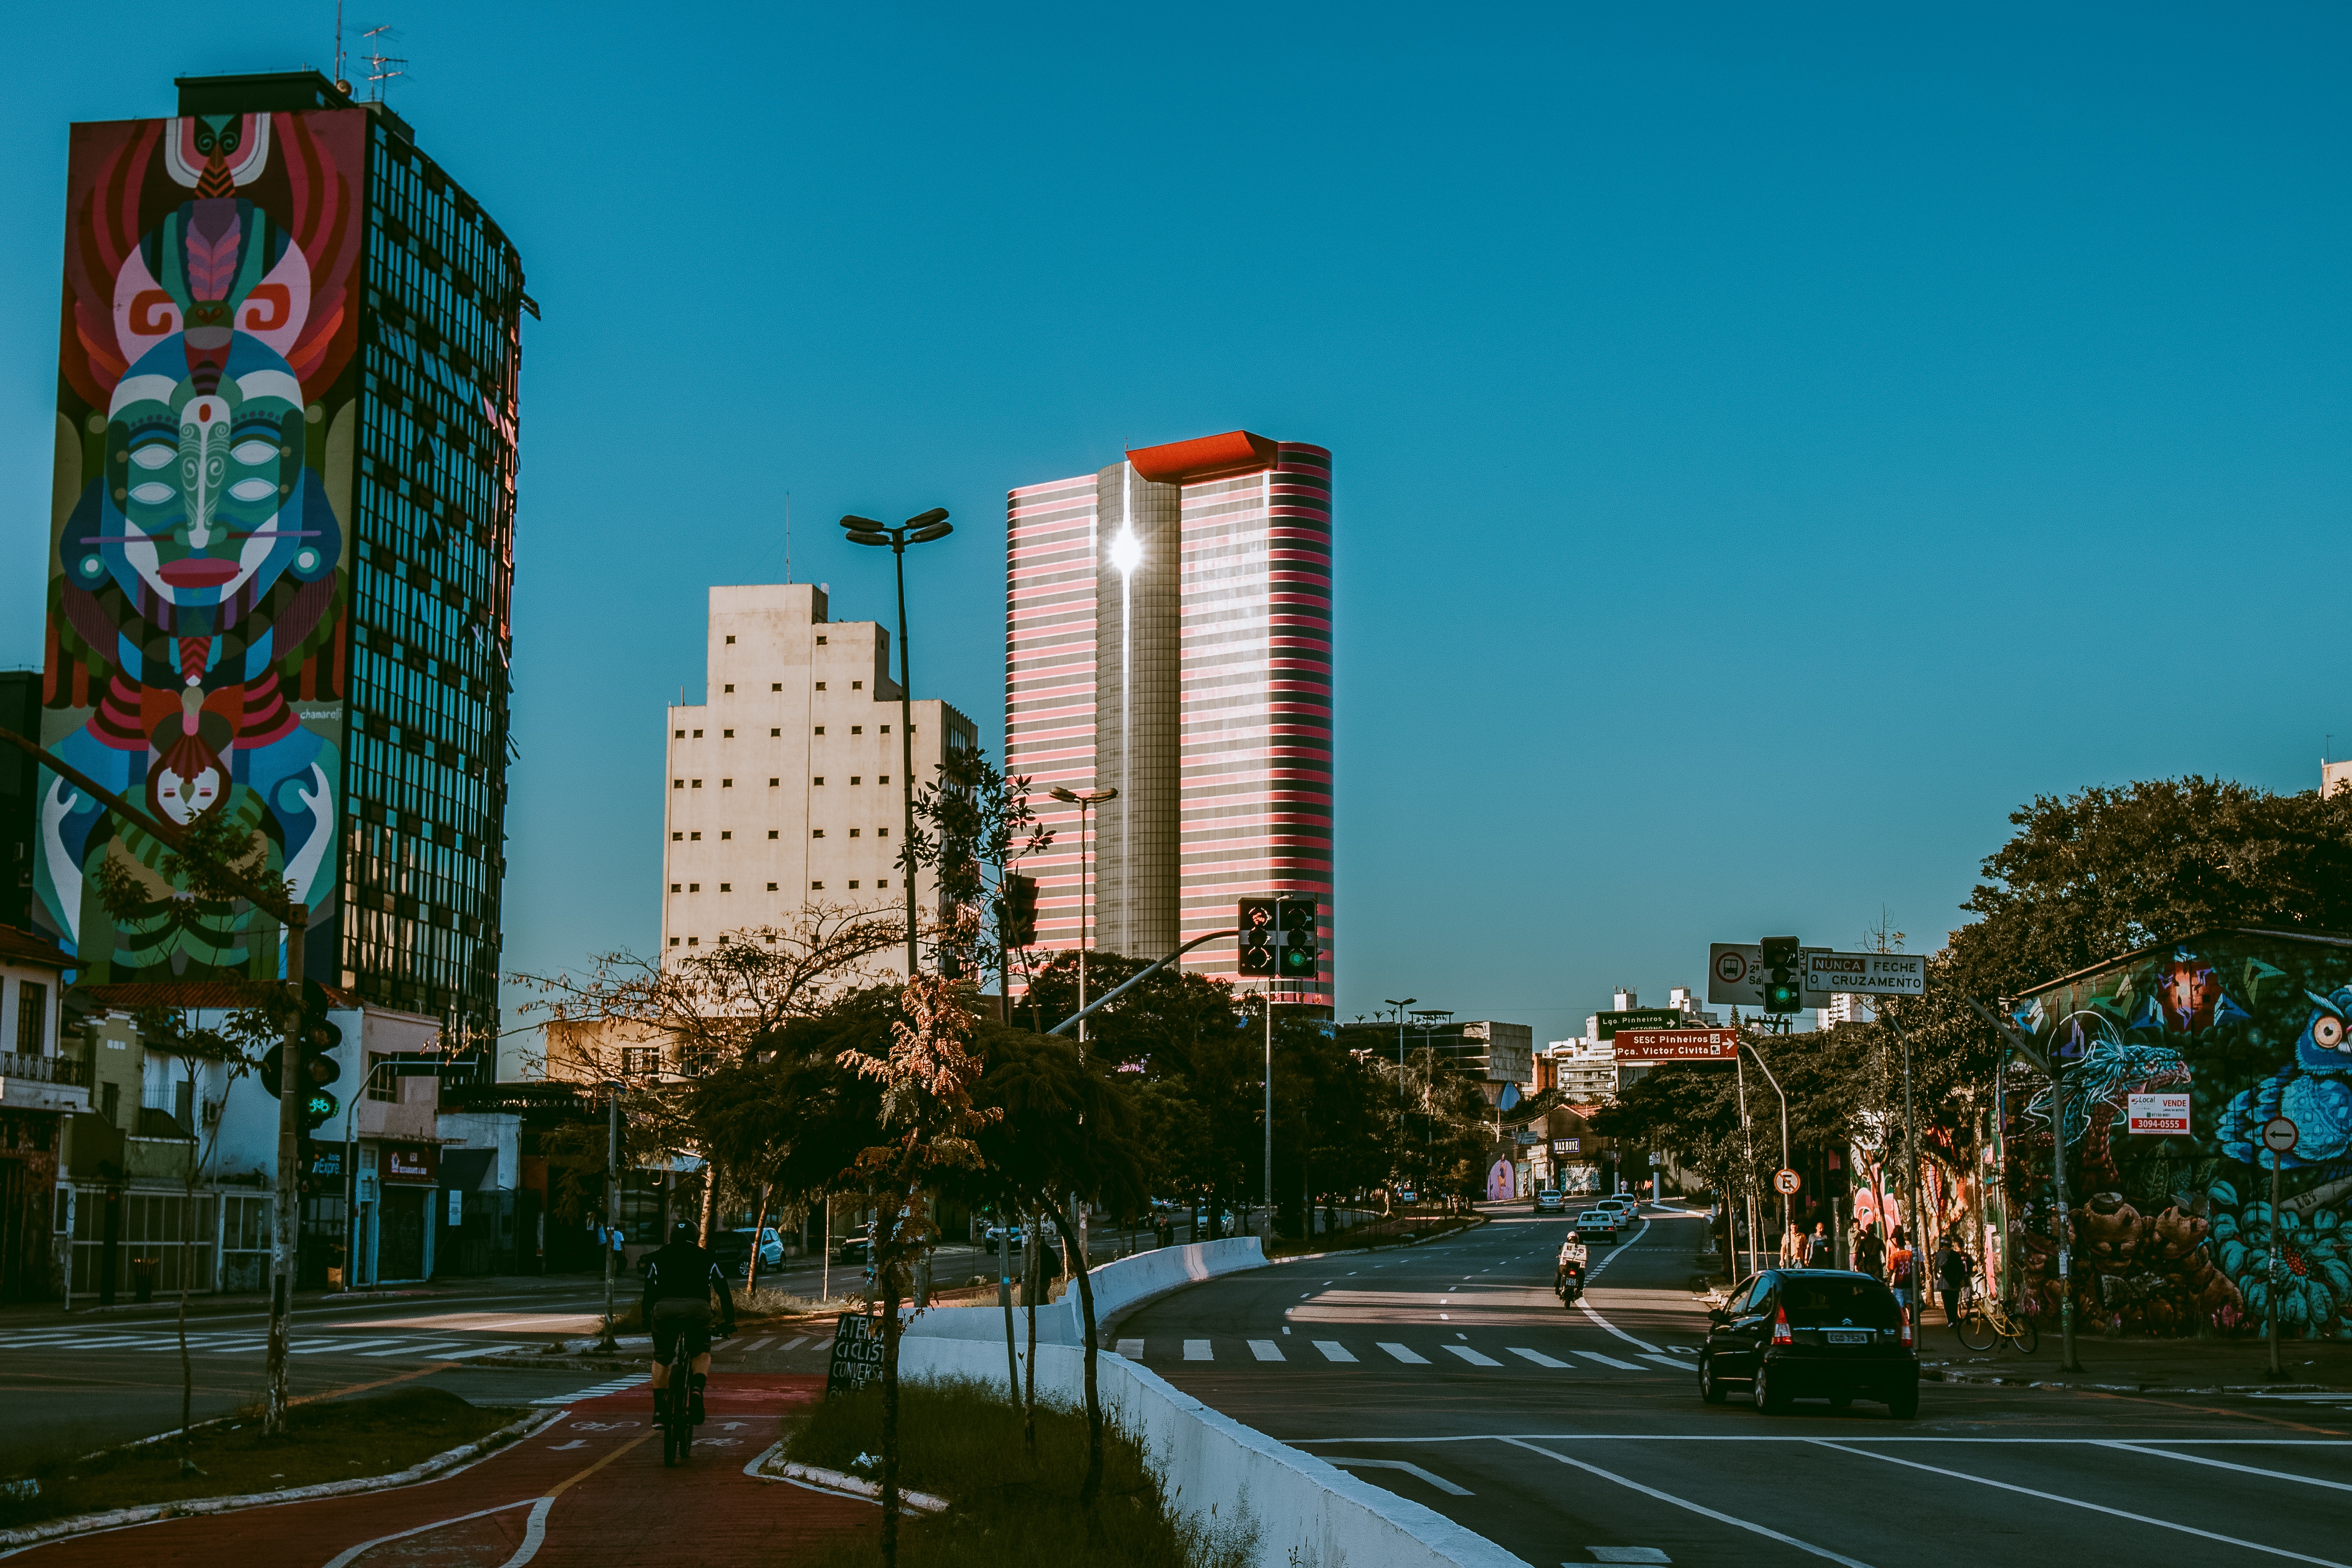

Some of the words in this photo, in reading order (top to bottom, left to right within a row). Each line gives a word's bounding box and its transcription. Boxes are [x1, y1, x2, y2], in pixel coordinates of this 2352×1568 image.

[1815, 960, 1861, 970] NUNCA
[1874, 962, 1916, 973] FECHE
[1749, 975, 1761, 985] Sá
[1810, 975, 1818, 984] O
[1832, 975, 1921, 988] CRUZAMENTO
[1618, 1048, 1639, 1056] Pça.
[2138, 1120, 2179, 1128] 3094-0555
[1555, 1141, 1565, 1151] WAX
[1565, 1141, 1578, 1151] BOYZ
[1782, 1174, 1792, 1189] E
[1899, 1261, 1910, 1275] 33
[838, 1316, 901, 1341] ATEN
[836, 1341, 884, 1362] CiCLiST
[833, 1361, 883, 1382] CONVERSÃ
[851, 1379, 866, 1390] DE
